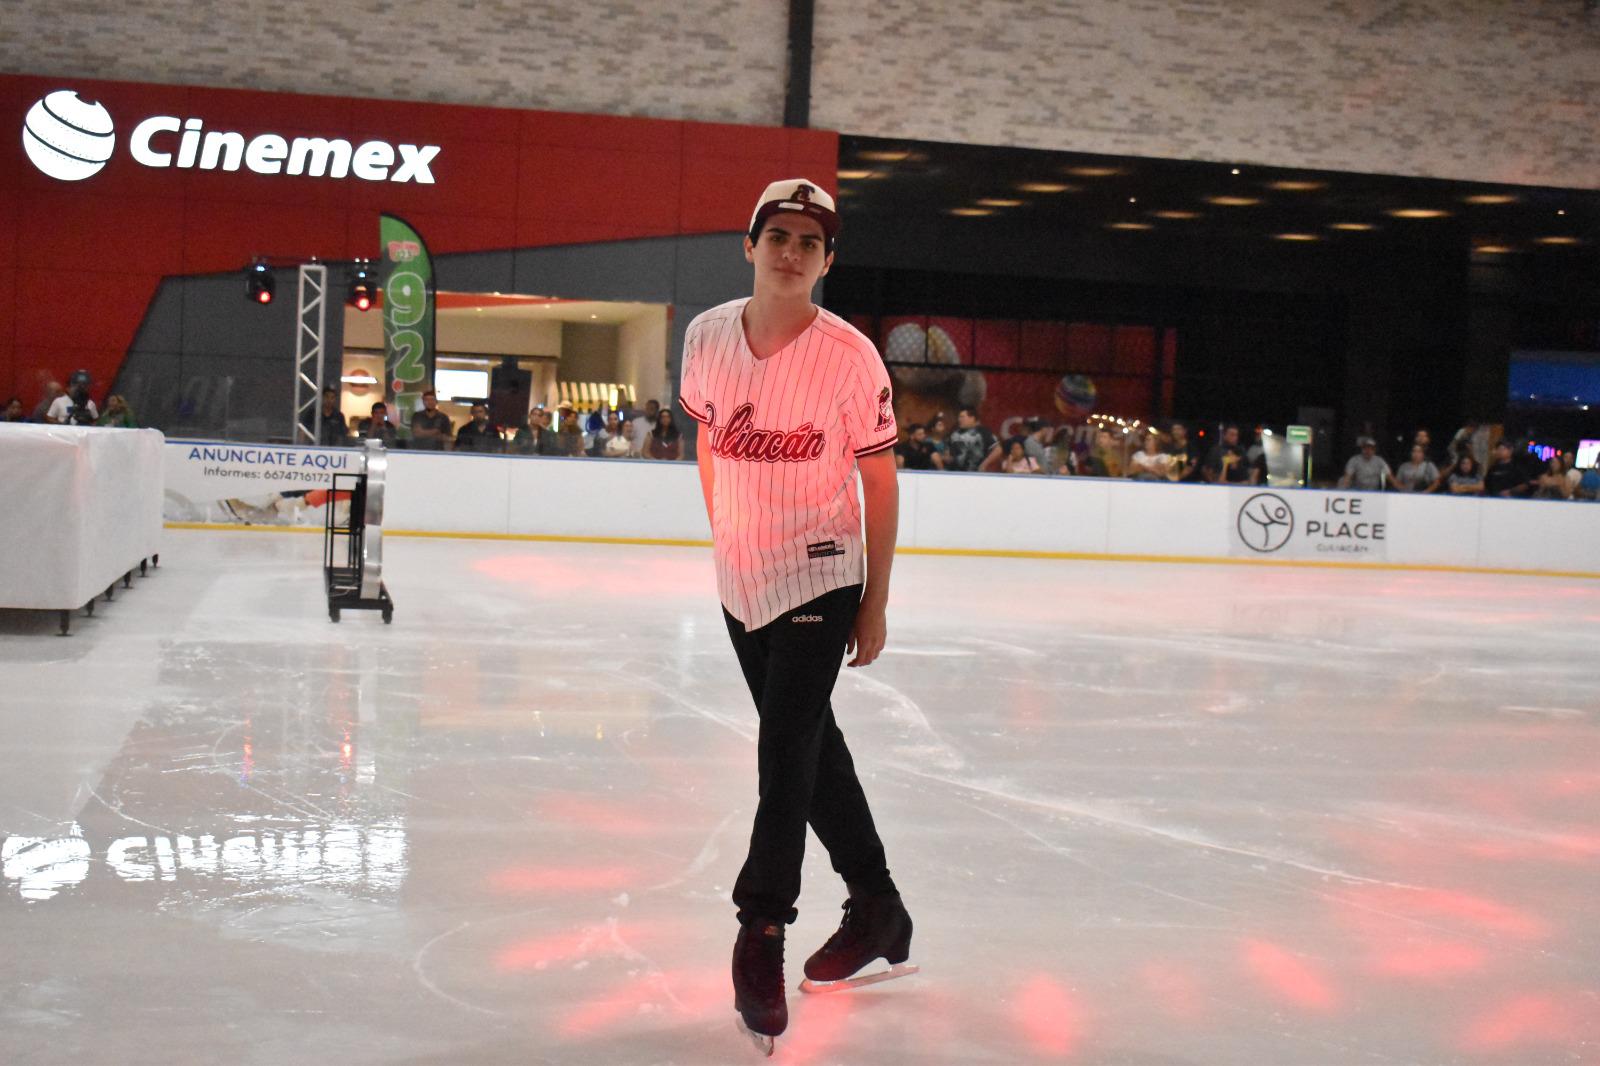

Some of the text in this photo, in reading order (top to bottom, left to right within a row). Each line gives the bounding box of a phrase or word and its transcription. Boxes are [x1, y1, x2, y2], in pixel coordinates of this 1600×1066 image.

[130, 115, 441, 185] Cinemex
[189, 447, 296, 467] ANUNCIATE
[203, 466, 331, 482] Informes: 6674716172
[1325, 497, 1362, 515] ICE
[1306, 520, 1385, 540] PLACE
[792, 614, 823, 623] adidas
